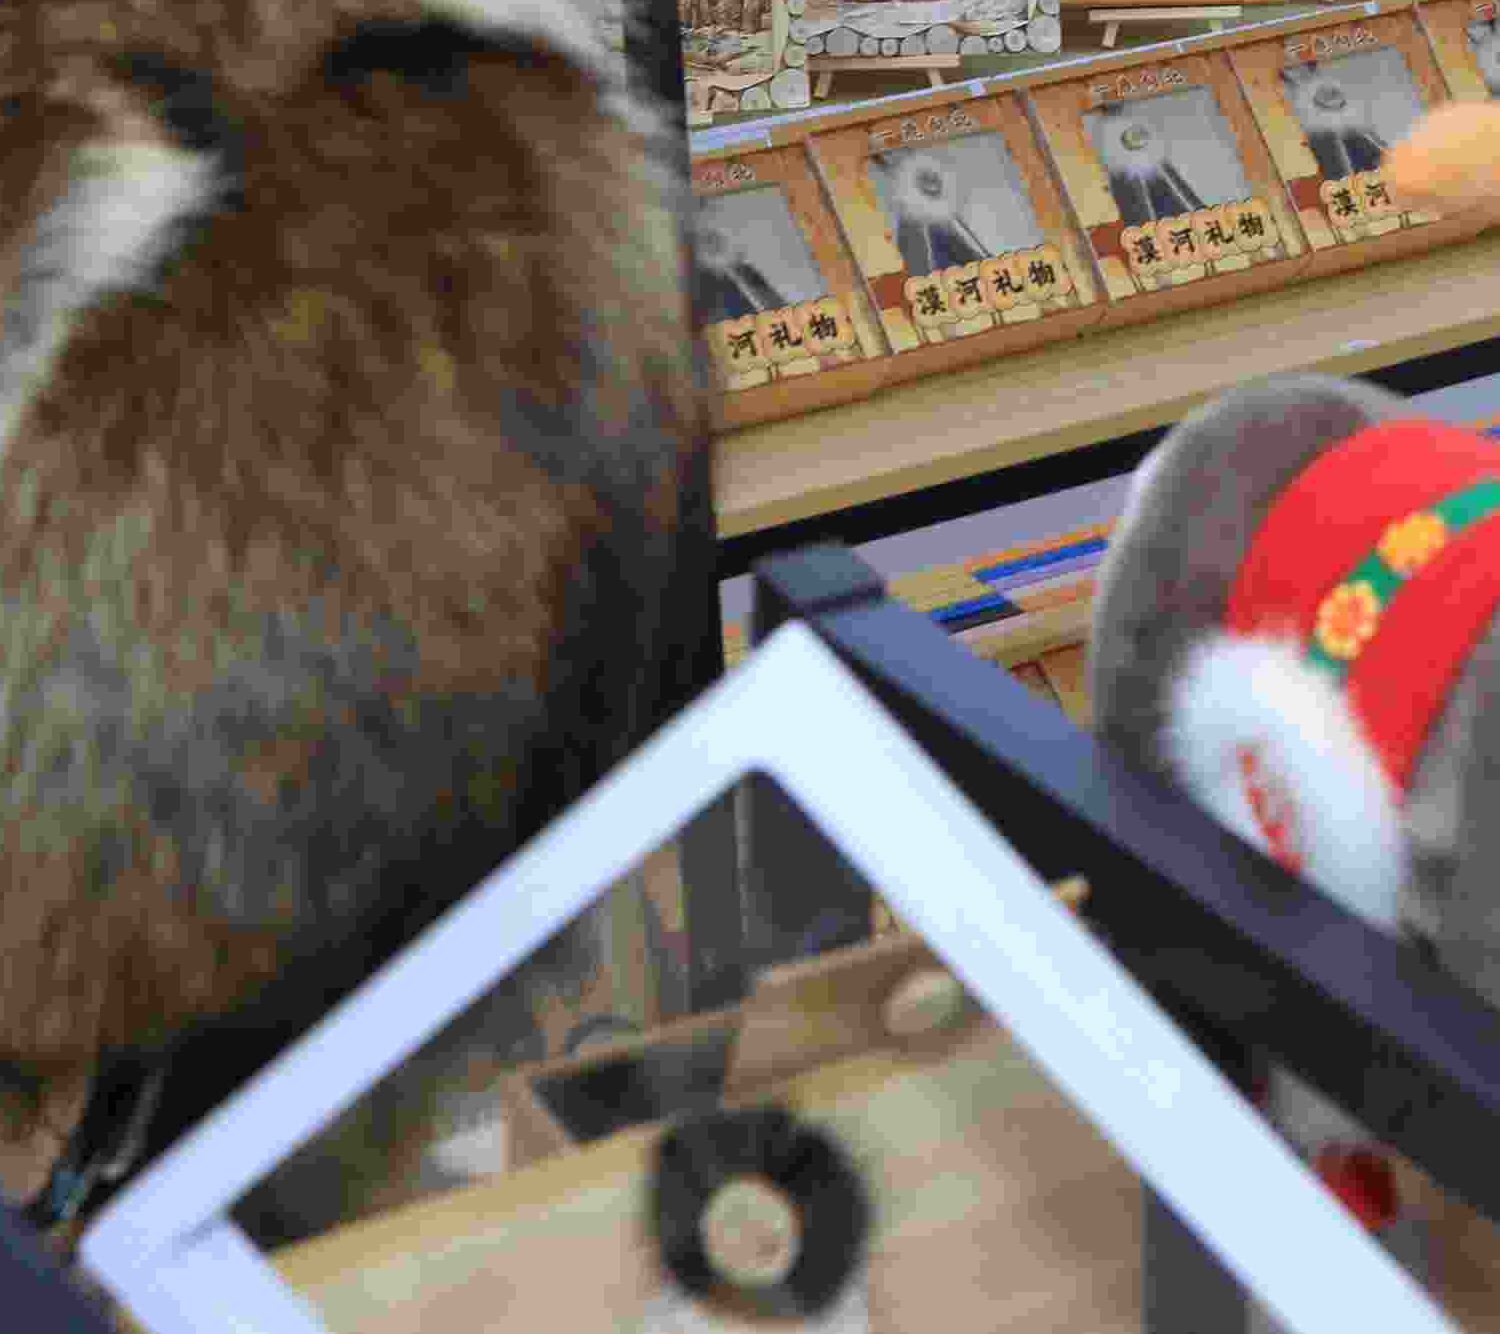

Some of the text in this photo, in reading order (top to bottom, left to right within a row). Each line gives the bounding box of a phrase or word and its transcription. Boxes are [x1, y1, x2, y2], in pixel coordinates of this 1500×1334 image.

[1333, 180, 1393, 218] 漠河
[1133, 211, 1265, 265] 漠河礼物
[916, 258, 1056, 316] 漠河礼物
[726, 313, 838, 359] 河礼物
